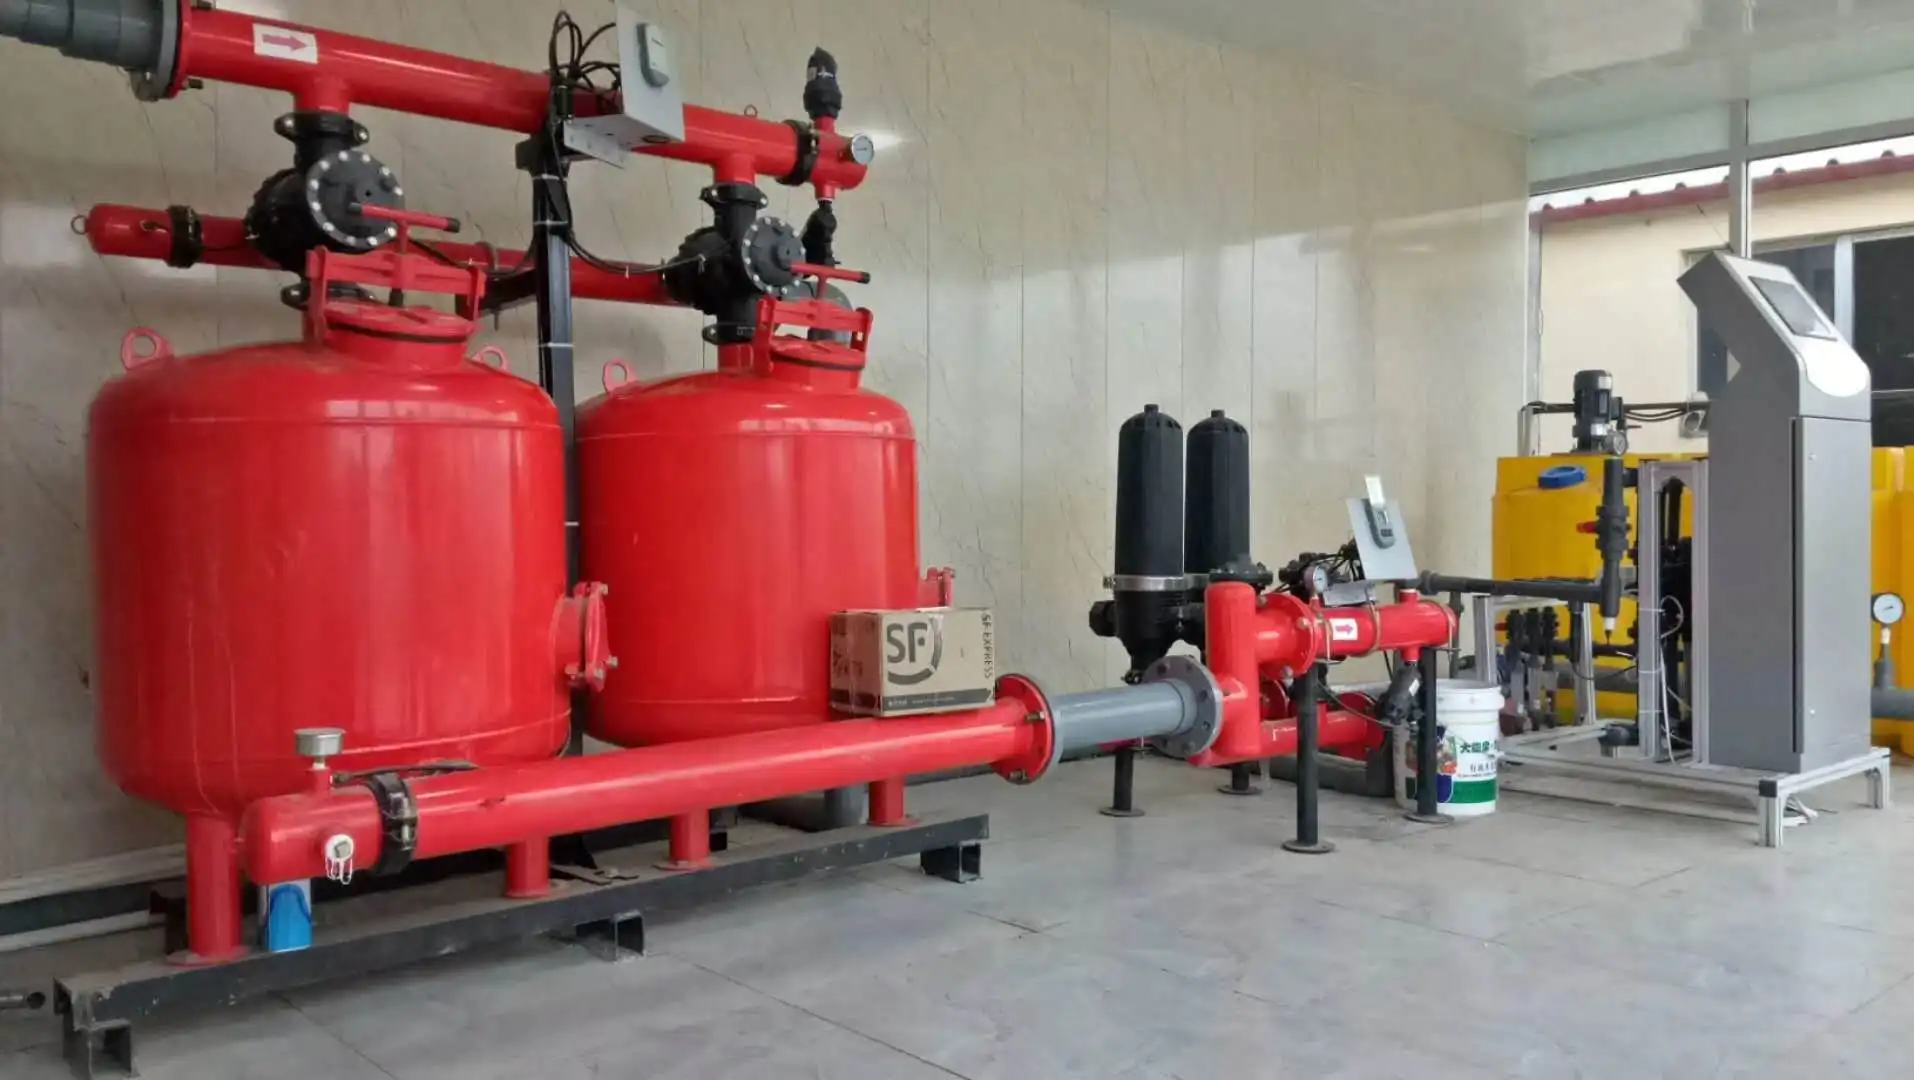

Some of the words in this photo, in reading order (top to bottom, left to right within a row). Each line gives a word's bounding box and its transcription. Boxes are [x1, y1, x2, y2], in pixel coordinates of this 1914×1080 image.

[981, 612, 992, 630] SF
[887, 622, 928, 663] SF
[983, 632, 993, 679] EXPRESS
